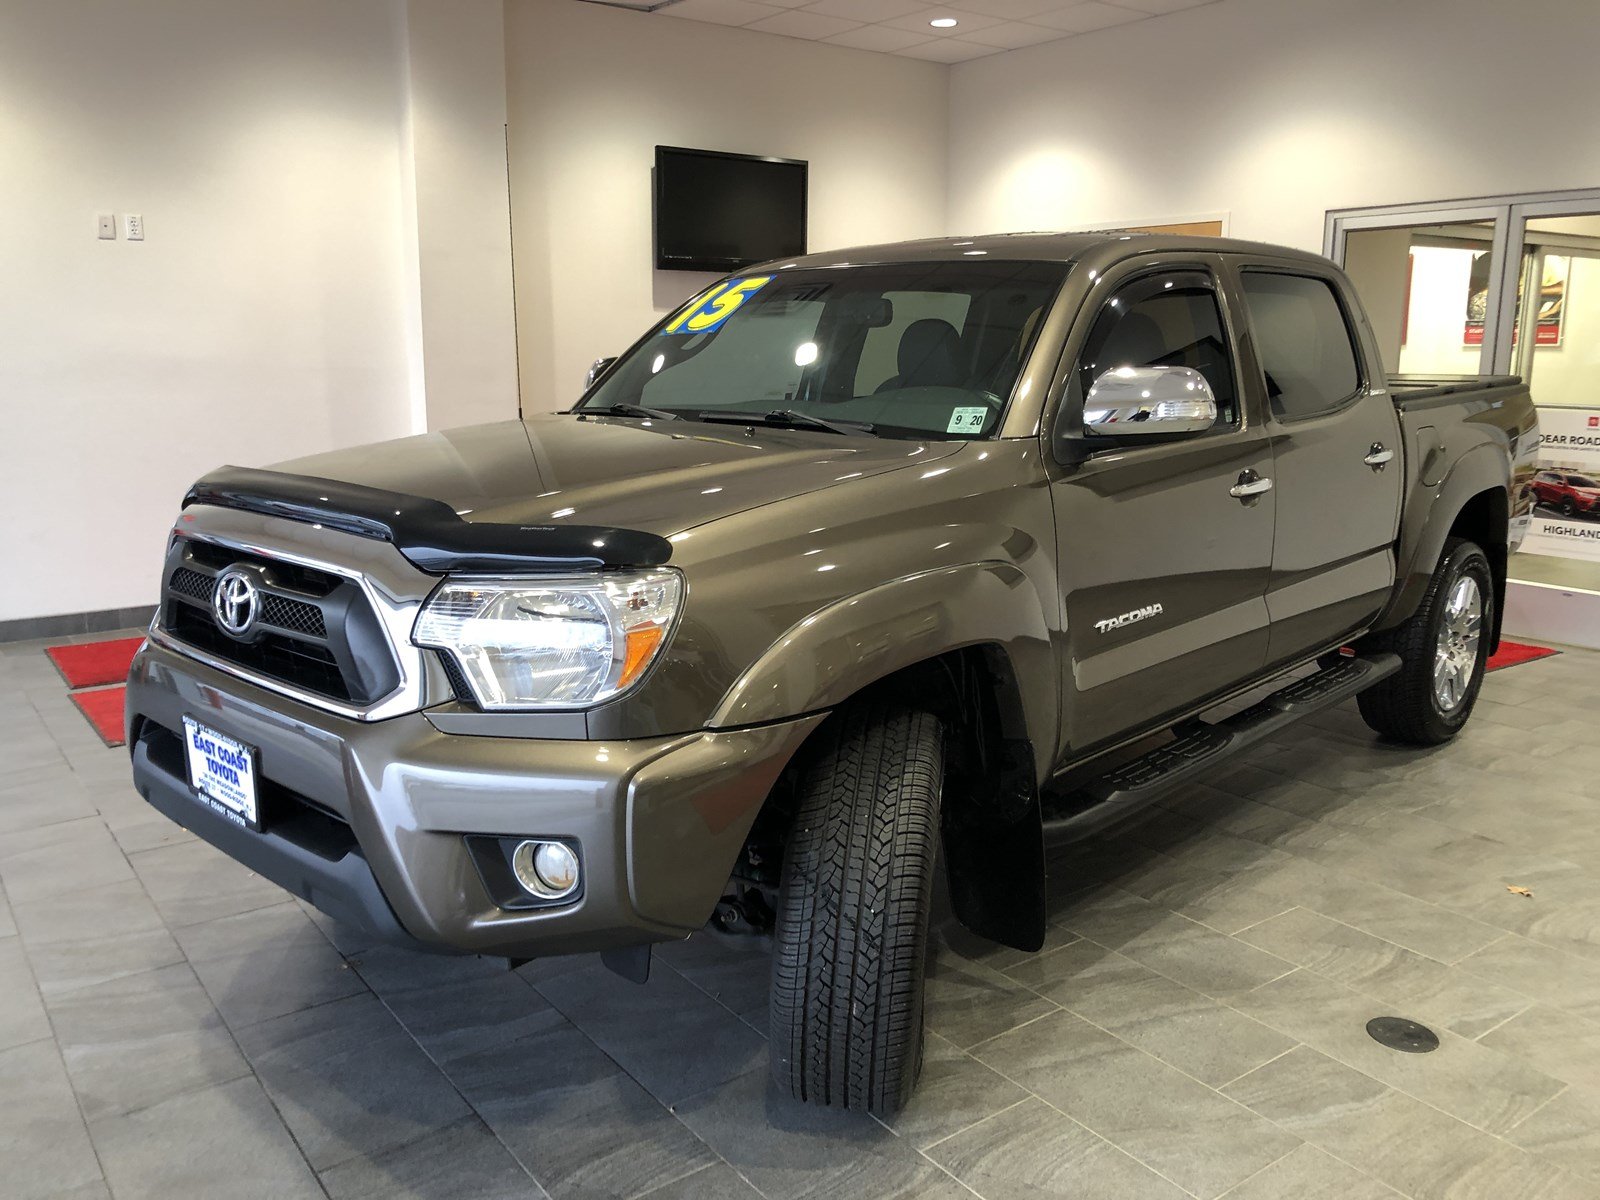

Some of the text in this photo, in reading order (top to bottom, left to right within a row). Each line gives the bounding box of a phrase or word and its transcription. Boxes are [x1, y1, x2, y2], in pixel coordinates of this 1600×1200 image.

[665, 277, 770, 334] 15
[954, 414, 983, 426] 9 20
[1539, 434, 1600, 446] DEAR ROAD
[1093, 603, 1163, 633] TACOMA
[193, 733, 248, 774] EAST COAST
[206, 757, 240, 787] TOYOTA
